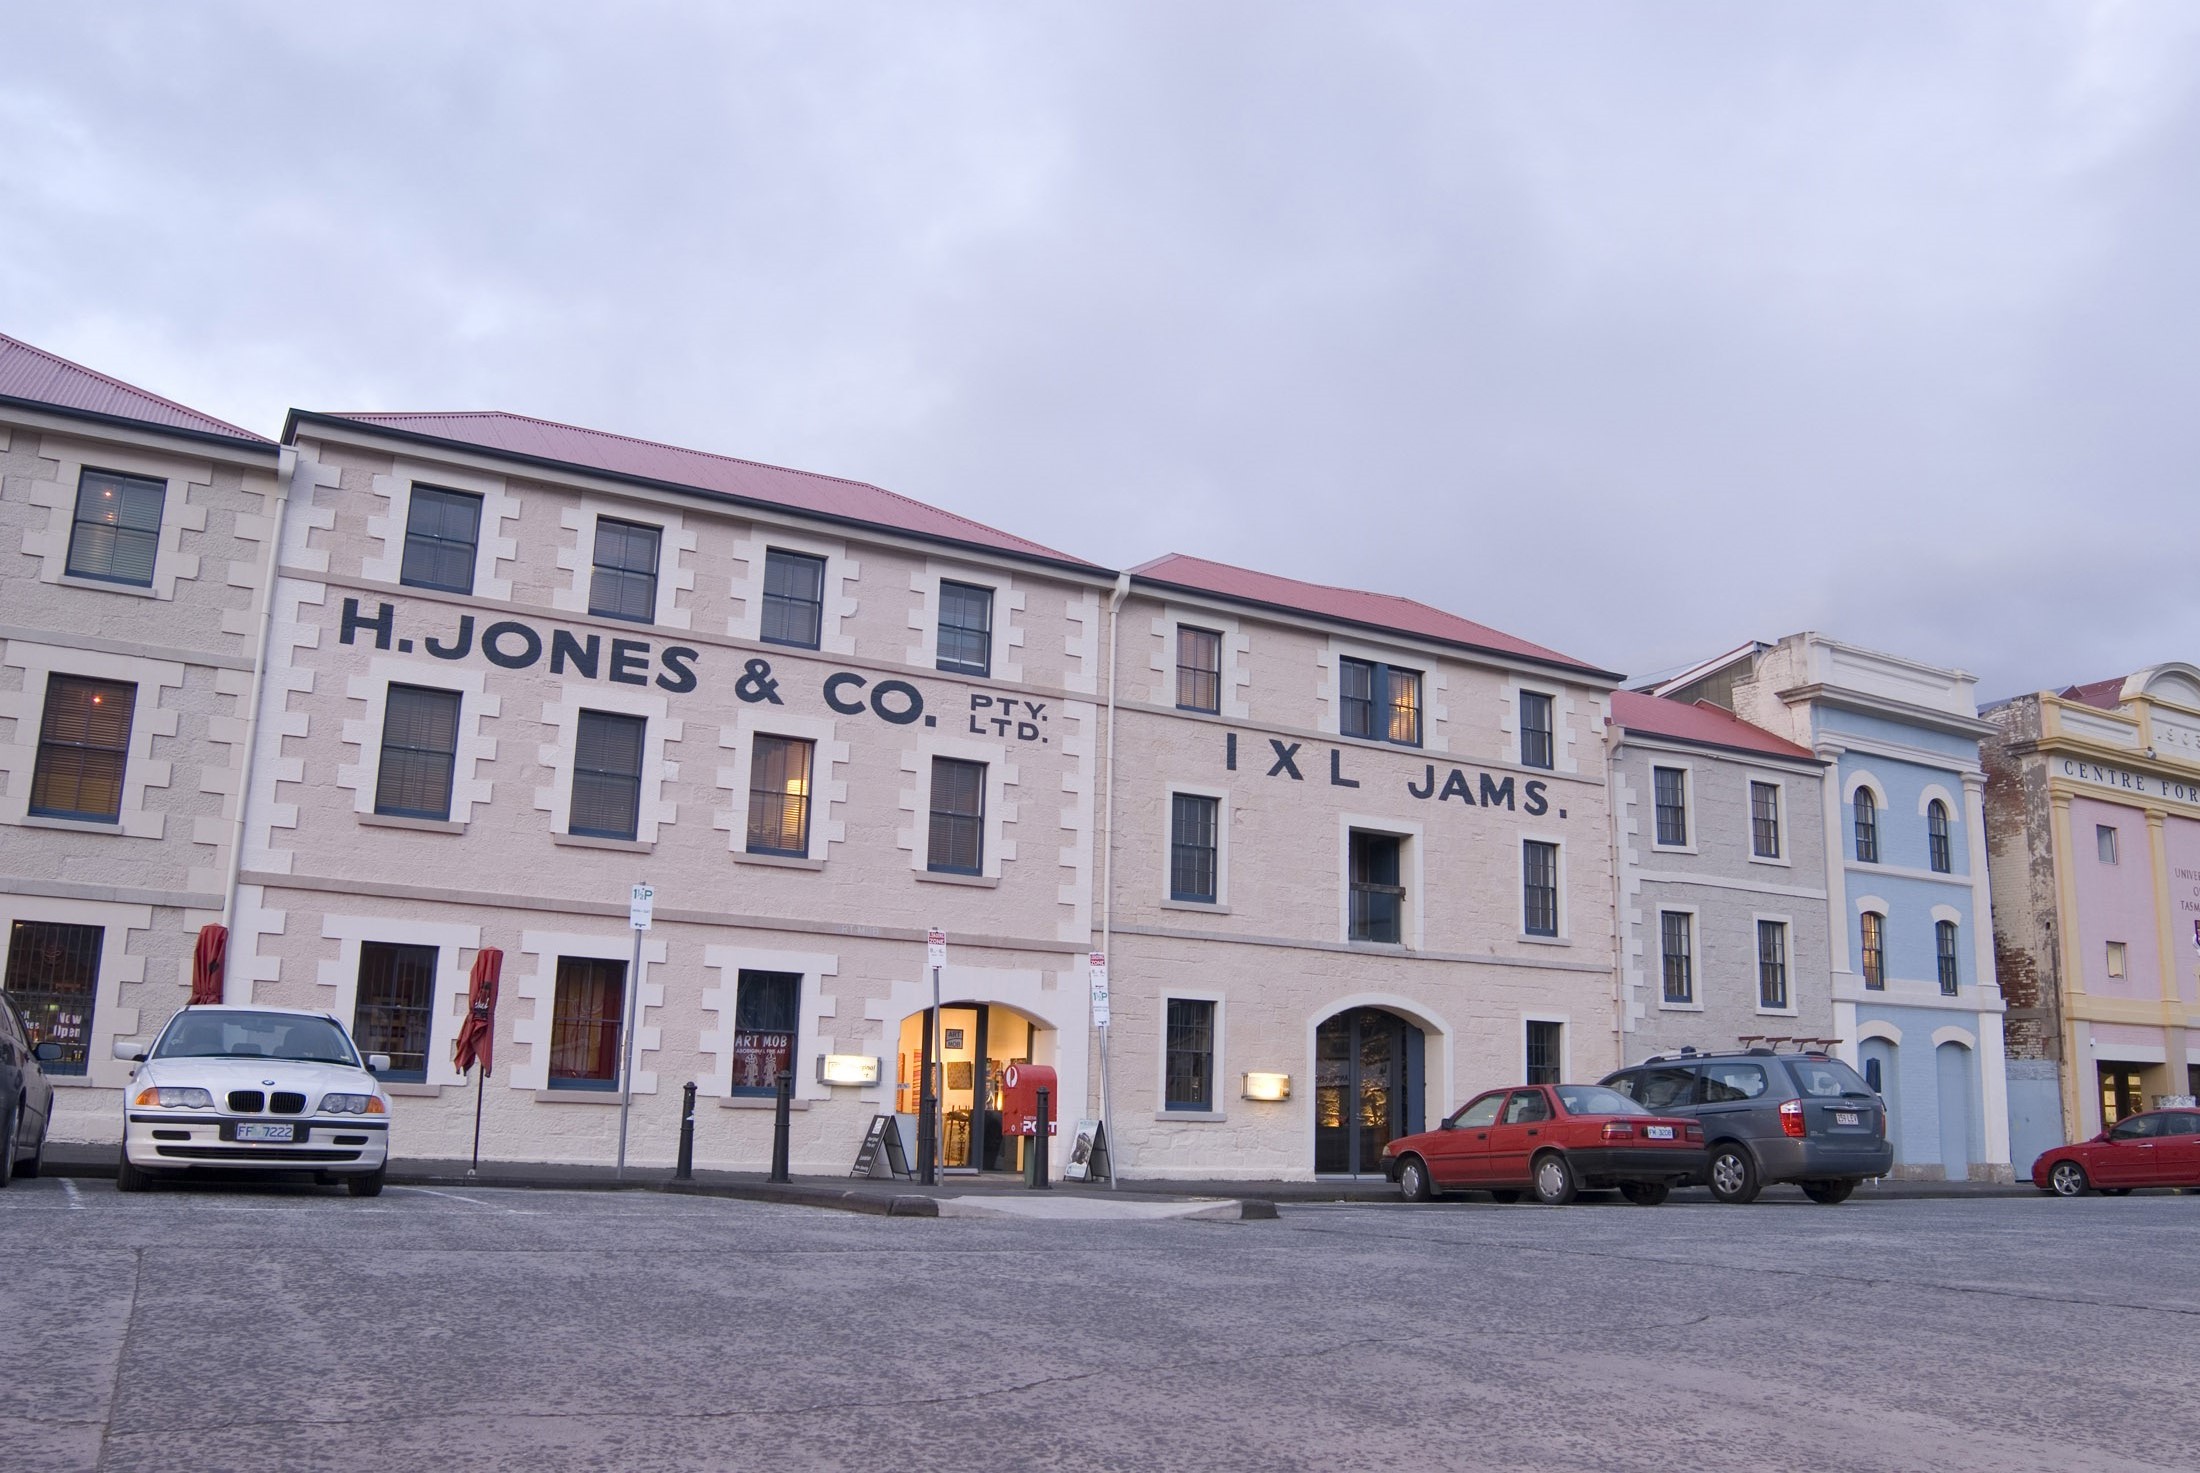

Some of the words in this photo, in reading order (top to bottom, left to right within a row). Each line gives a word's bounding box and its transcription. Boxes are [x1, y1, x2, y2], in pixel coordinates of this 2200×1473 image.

[734, 658, 785, 706] &
[823, 671, 937, 728] CO.
[970, 693, 1048, 722] PTY.
[969, 714, 1048, 744] LTD.
[1407, 764, 1568, 819] JAMS.
[2064, 760, 2146, 791] CENTRE
[2161, 780, 2199, 803] FOR
[2180, 900, 2200, 912] TASM
[59, 1012, 82, 1025] Now
[53, 1025, 81, 1038] Open
[735, 1034, 760, 1047] ART
[762, 1035, 788, 1048] MOB
[238, 1126, 254, 1137] FF
[263, 1127, 293, 1138] 7222
